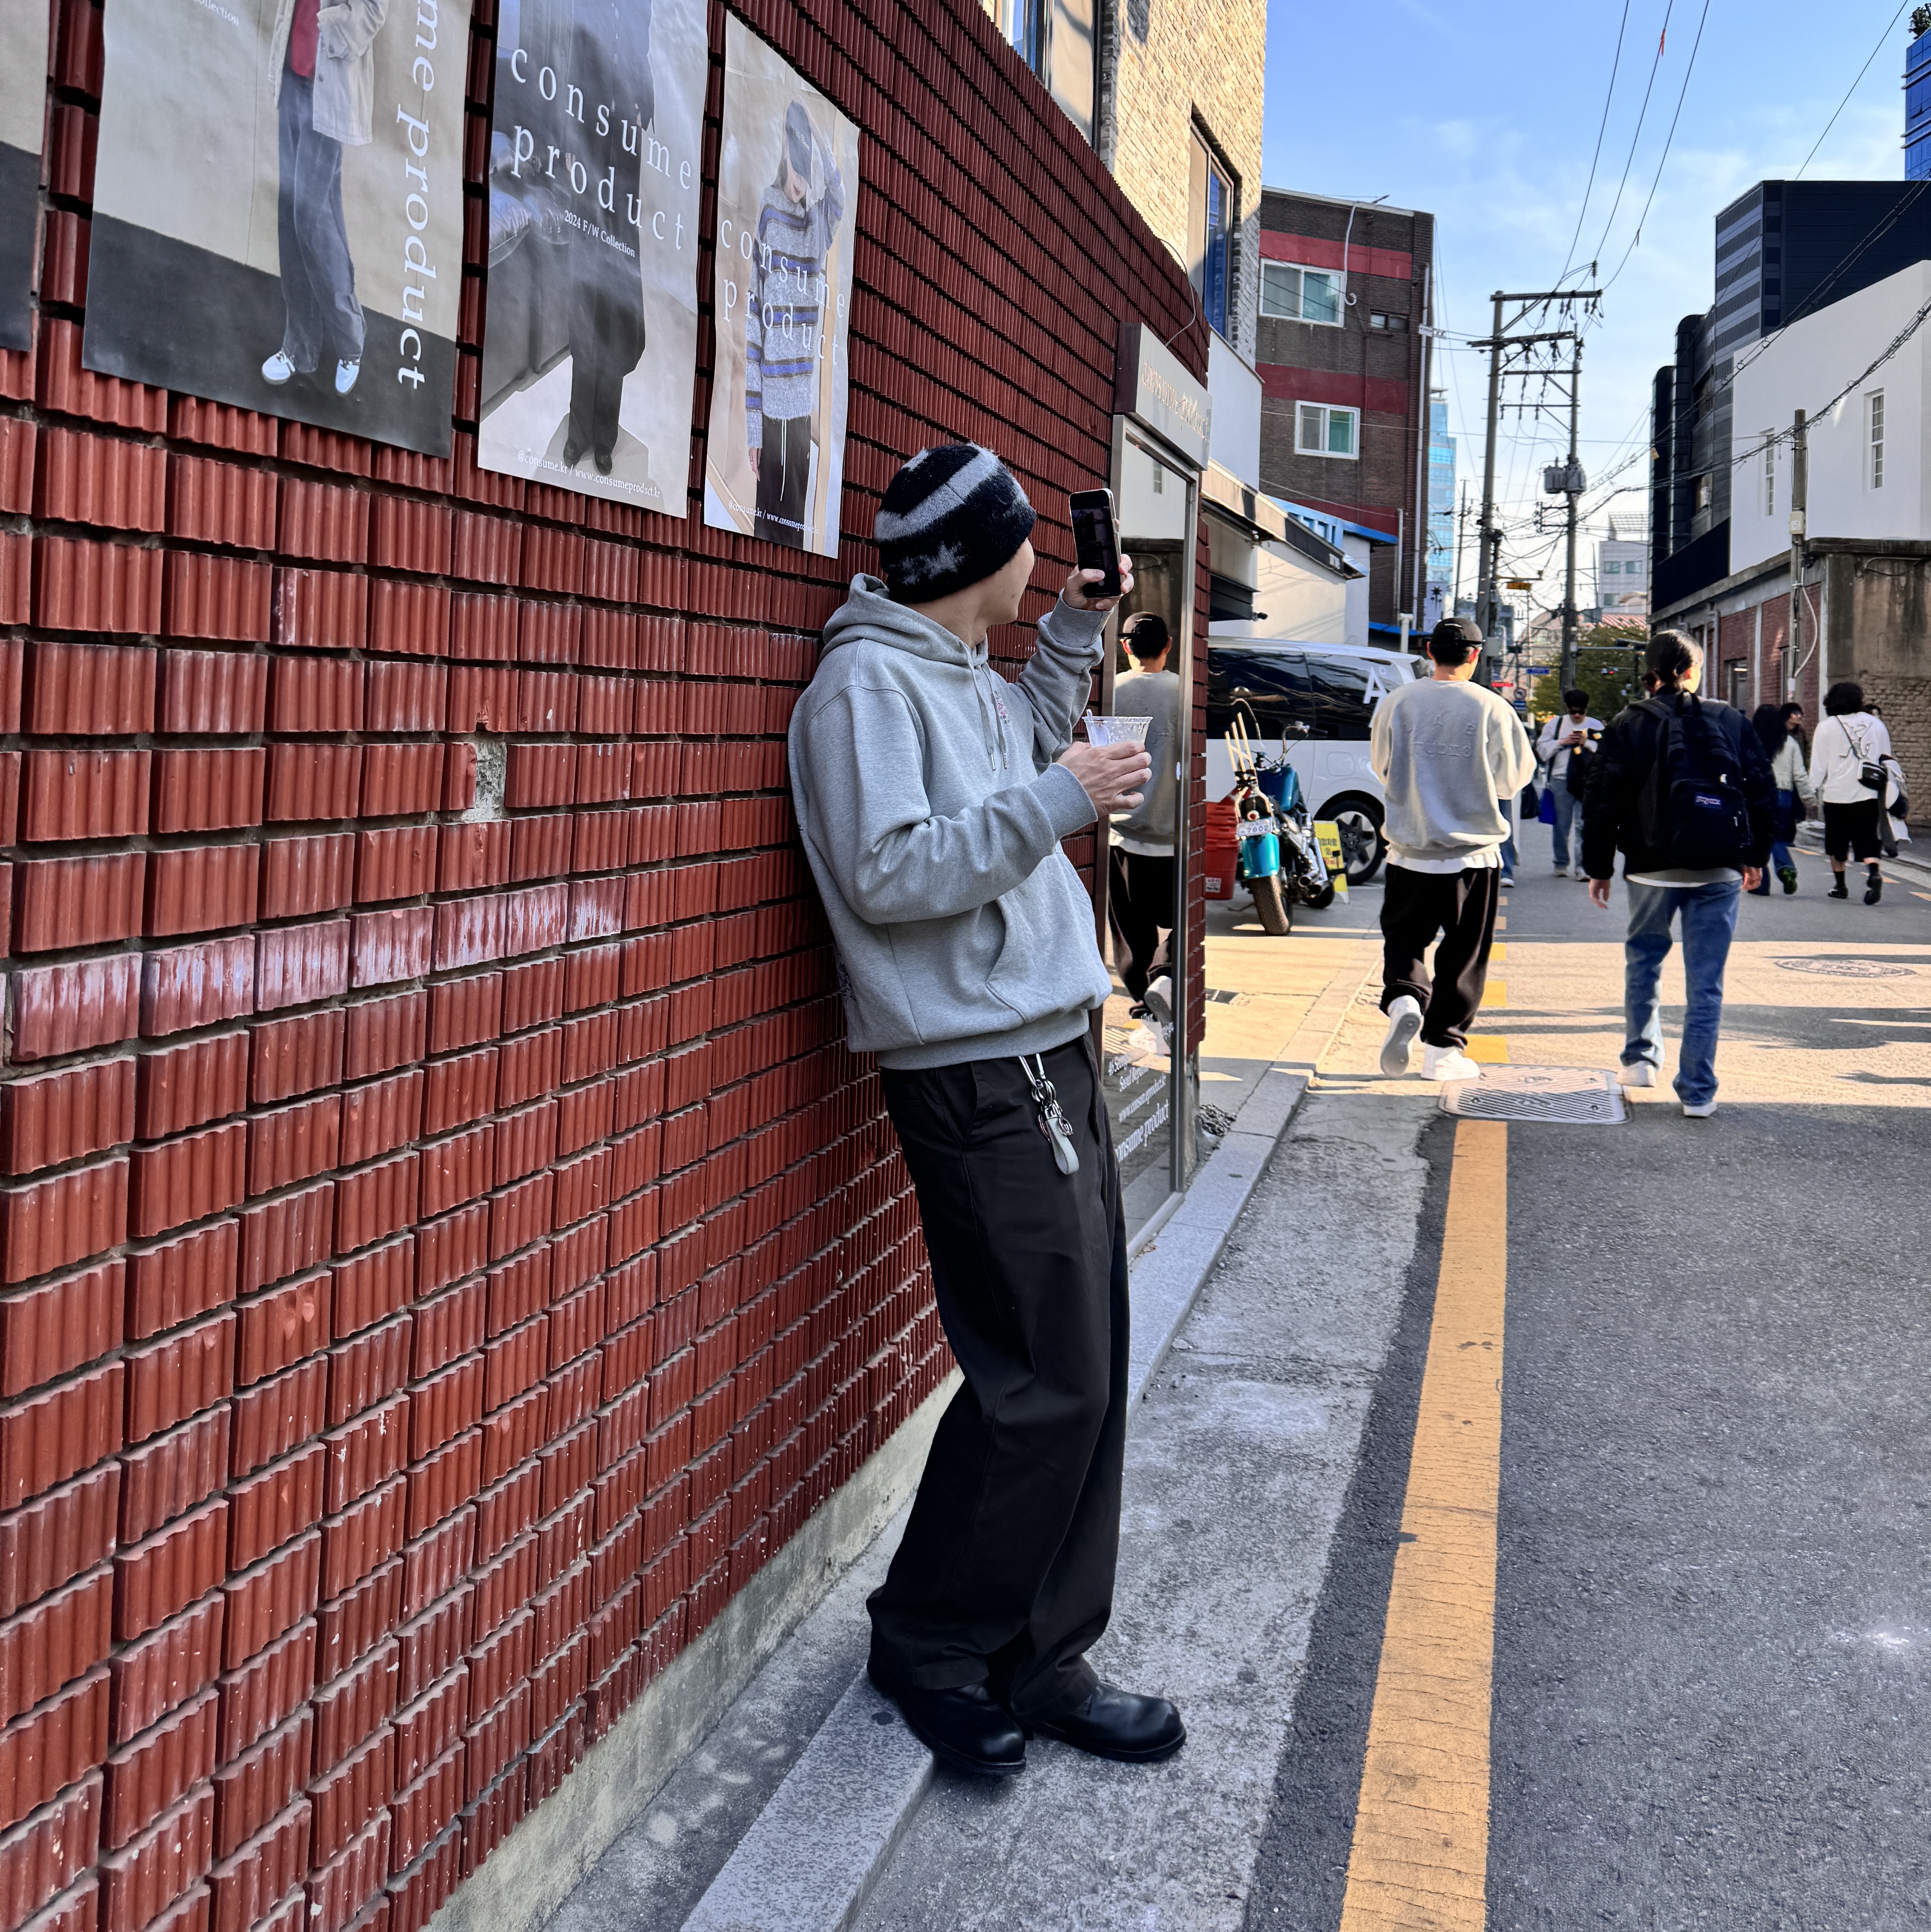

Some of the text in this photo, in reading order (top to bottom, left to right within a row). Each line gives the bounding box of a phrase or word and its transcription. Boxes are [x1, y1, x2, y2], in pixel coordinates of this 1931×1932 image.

[194, 0, 239, 26] ollection
[511, 48, 692, 189] consume
[511, 125, 684, 250] product
[564, 210, 581, 229] 2024
[601, 230, 635, 258] Collection
[396, 103, 436, 390] product
[721, 220, 845, 319] consume
[724, 279, 838, 366] product
[518, 450, 568, 474] @consume.kr
[575, 468, 660, 498] www.consumeproduct.kr
